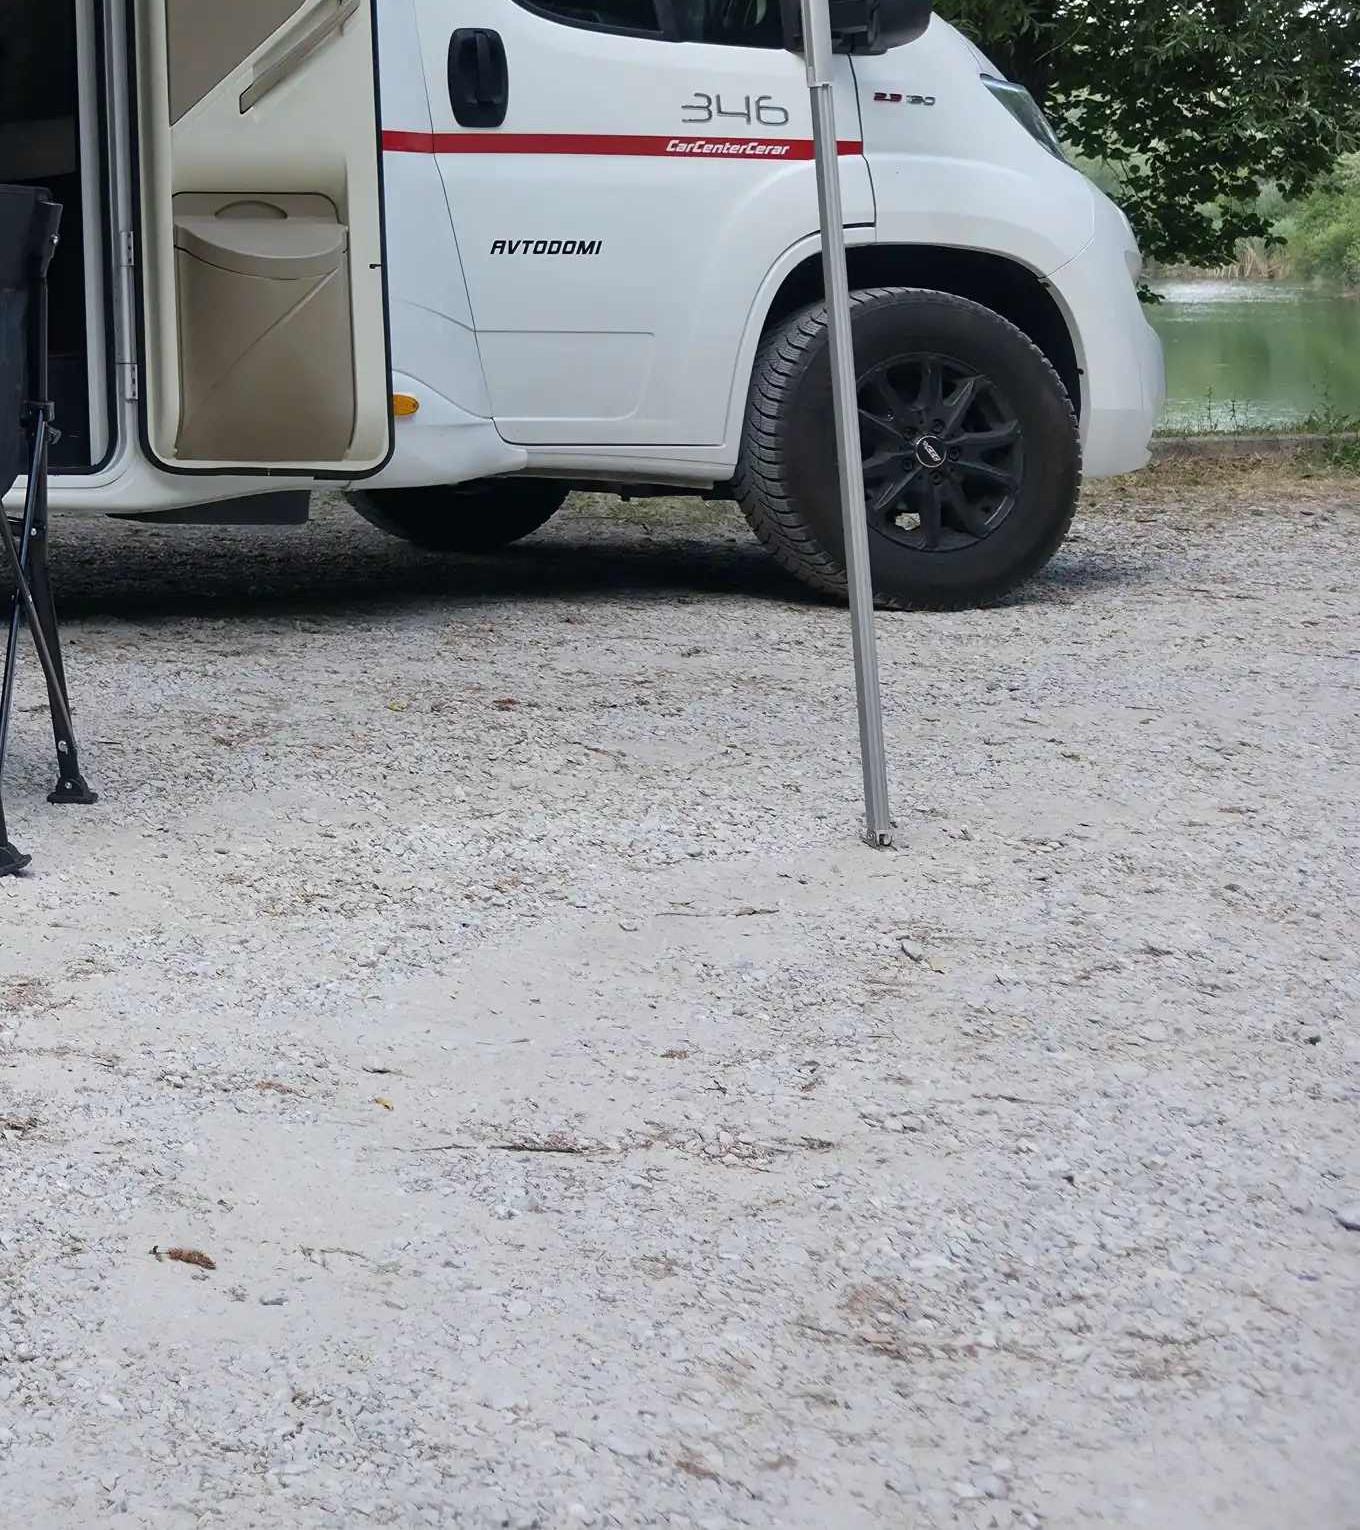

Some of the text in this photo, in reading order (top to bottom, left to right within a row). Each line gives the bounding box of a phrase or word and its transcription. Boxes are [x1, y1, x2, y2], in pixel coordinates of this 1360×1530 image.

[681, 92, 789, 126] 346
[666, 139, 790, 156] CarCenterCerar
[490, 240, 603, 255] AVTODOMI
